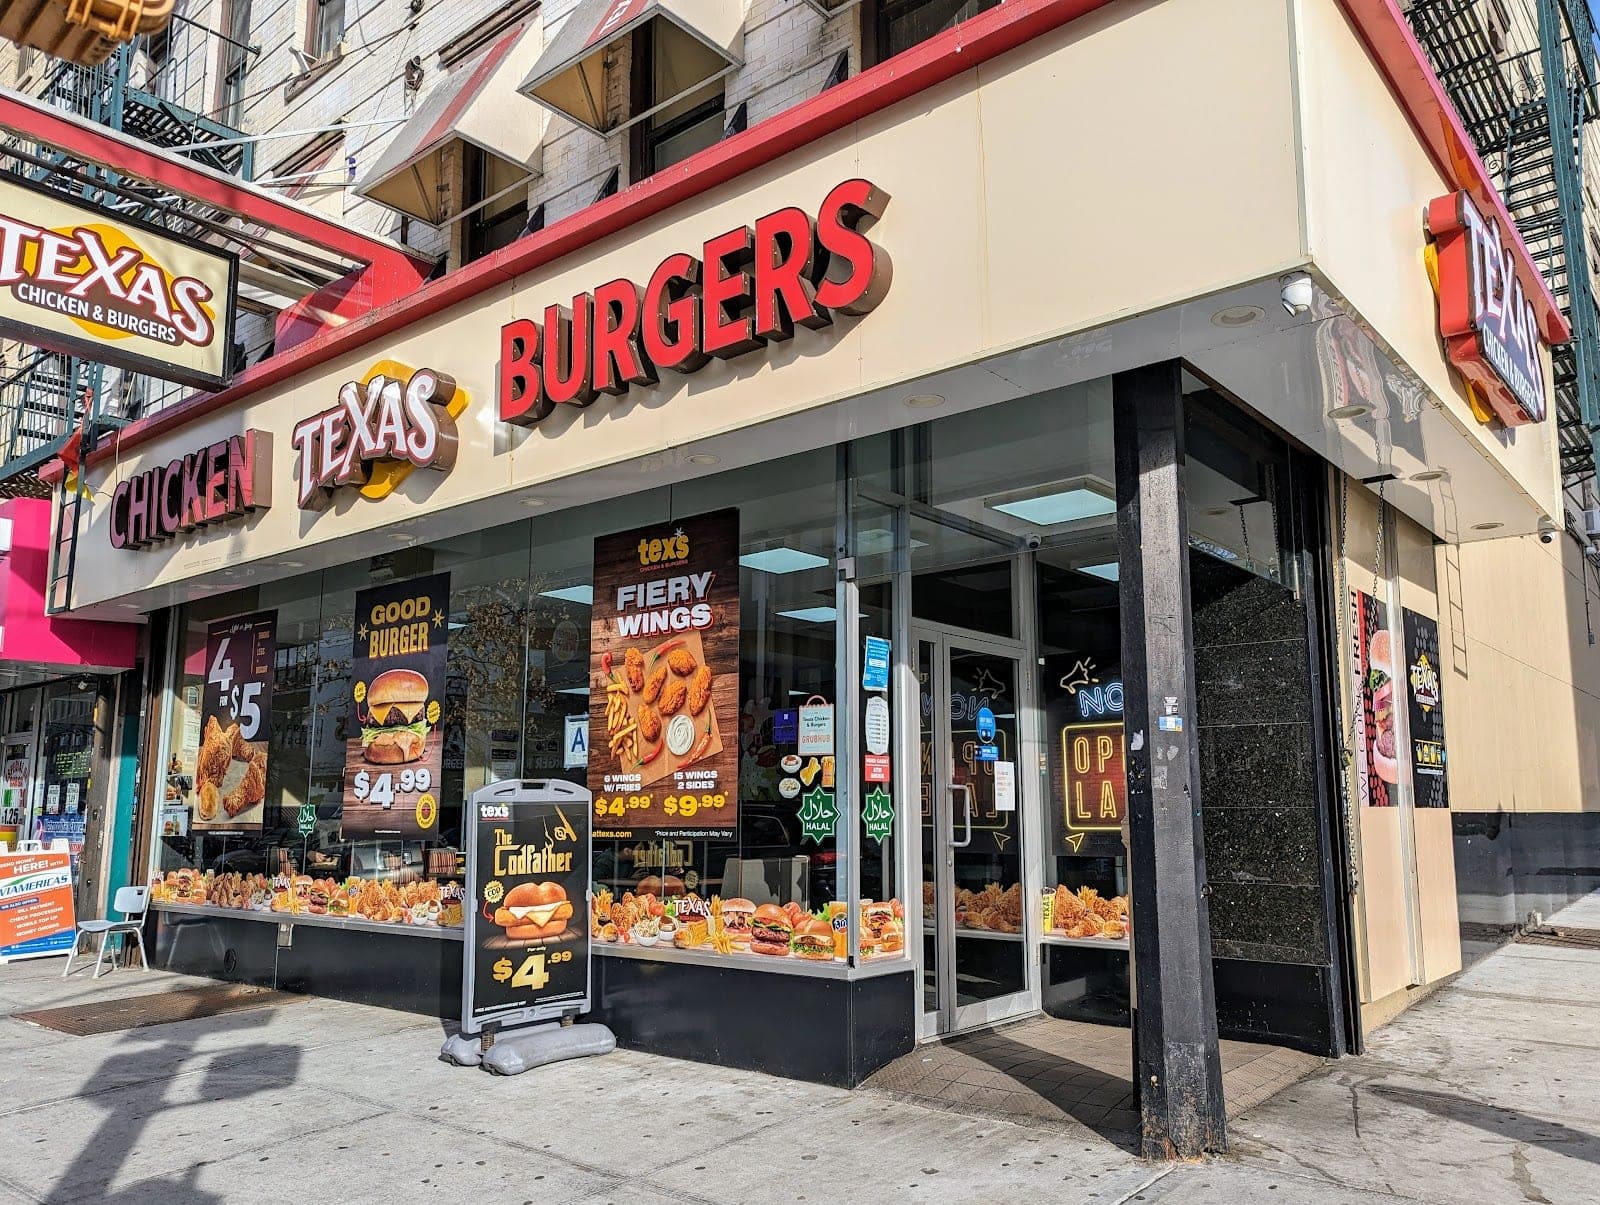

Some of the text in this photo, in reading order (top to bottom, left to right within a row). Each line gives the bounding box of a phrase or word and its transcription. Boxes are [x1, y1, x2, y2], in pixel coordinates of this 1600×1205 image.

[0, 215, 213, 346] TEXAS
[18, 282, 176, 344] CHICKEN & BURGERS
[499, 178, 888, 424] BURGERS
[1463, 193, 1545, 422] TEXAS
[294, 368, 440, 504] TEXAS
[110, 430, 258, 549] CHICKEN
[616, 571, 714, 613] FIERY
[370, 596, 431, 625] GOOD
[616, 603, 712, 638] WINGS
[368, 621, 429, 659] BURGER
[1350, 590, 1361, 675] FRESH
[208, 638, 234, 691] 4
[1410, 662, 1439, 703] TEXAS
[1079, 682, 1123, 718] NO
[571, 726, 586, 753] A
[1074, 735, 1124, 774] OP
[353, 768, 431, 809] $4.99
[604, 773, 642, 783] 6 WINGS
[616, 783, 641, 792] FRIES
[674, 770, 718, 780] 15 WINGS
[678, 781, 714, 790] 2 SIDES
[803, 799, 834, 820] حلال
[866, 800, 890, 821] حلال
[1076, 780, 1117, 818] LA
[494, 828, 513, 845] The
[806, 822, 831, 831] HALAL
[868, 822, 889, 831] HALAL
[13, 860, 49, 875] HERE!
[494, 843, 573, 877] Codfather
[0, 875, 68, 897] VIAMERICAS
[438, 886, 466, 901] TEXAS
[487, 887, 501, 897] COD
[30, 900, 55, 911] PAYMENT
[673, 897, 711, 918] TEXAS
[492, 950, 573, 990] $4.99
